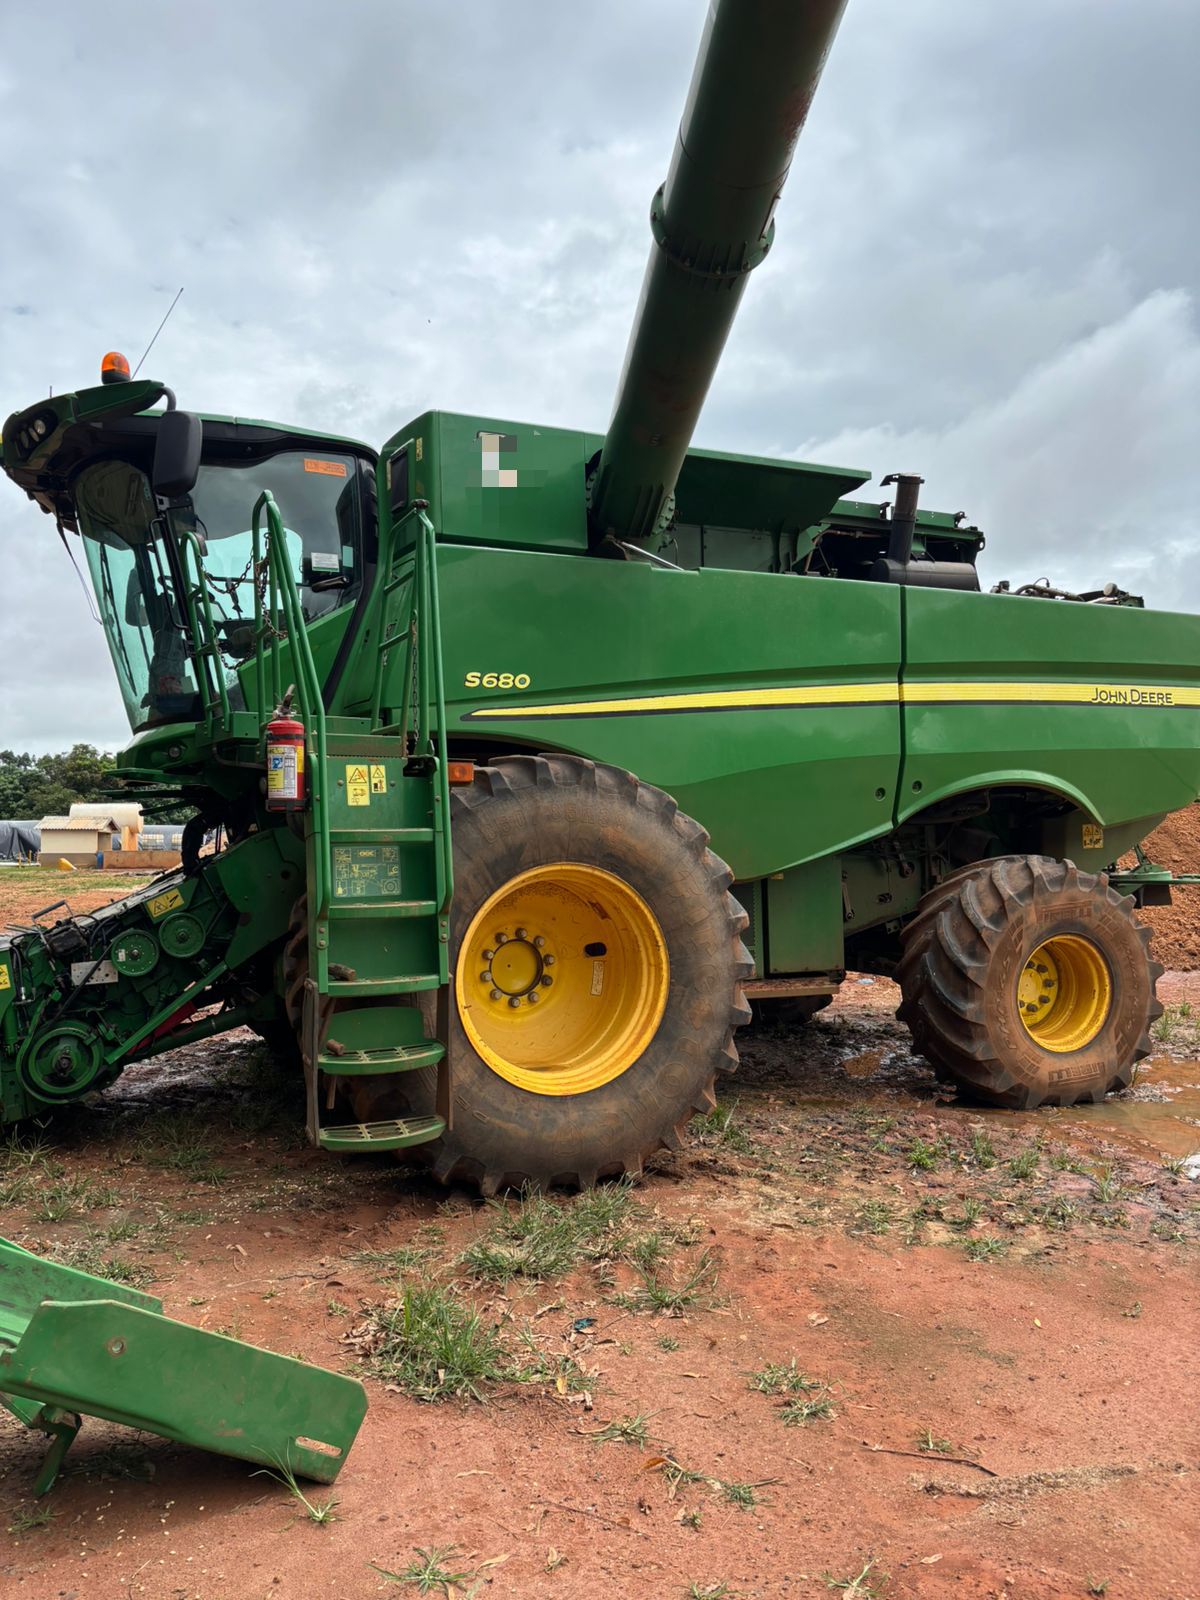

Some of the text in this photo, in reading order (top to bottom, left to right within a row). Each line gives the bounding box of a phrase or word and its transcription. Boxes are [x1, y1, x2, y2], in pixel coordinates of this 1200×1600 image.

[464, 671, 531, 689] S680
[1091, 687, 1173, 704] JOHN DEERE
